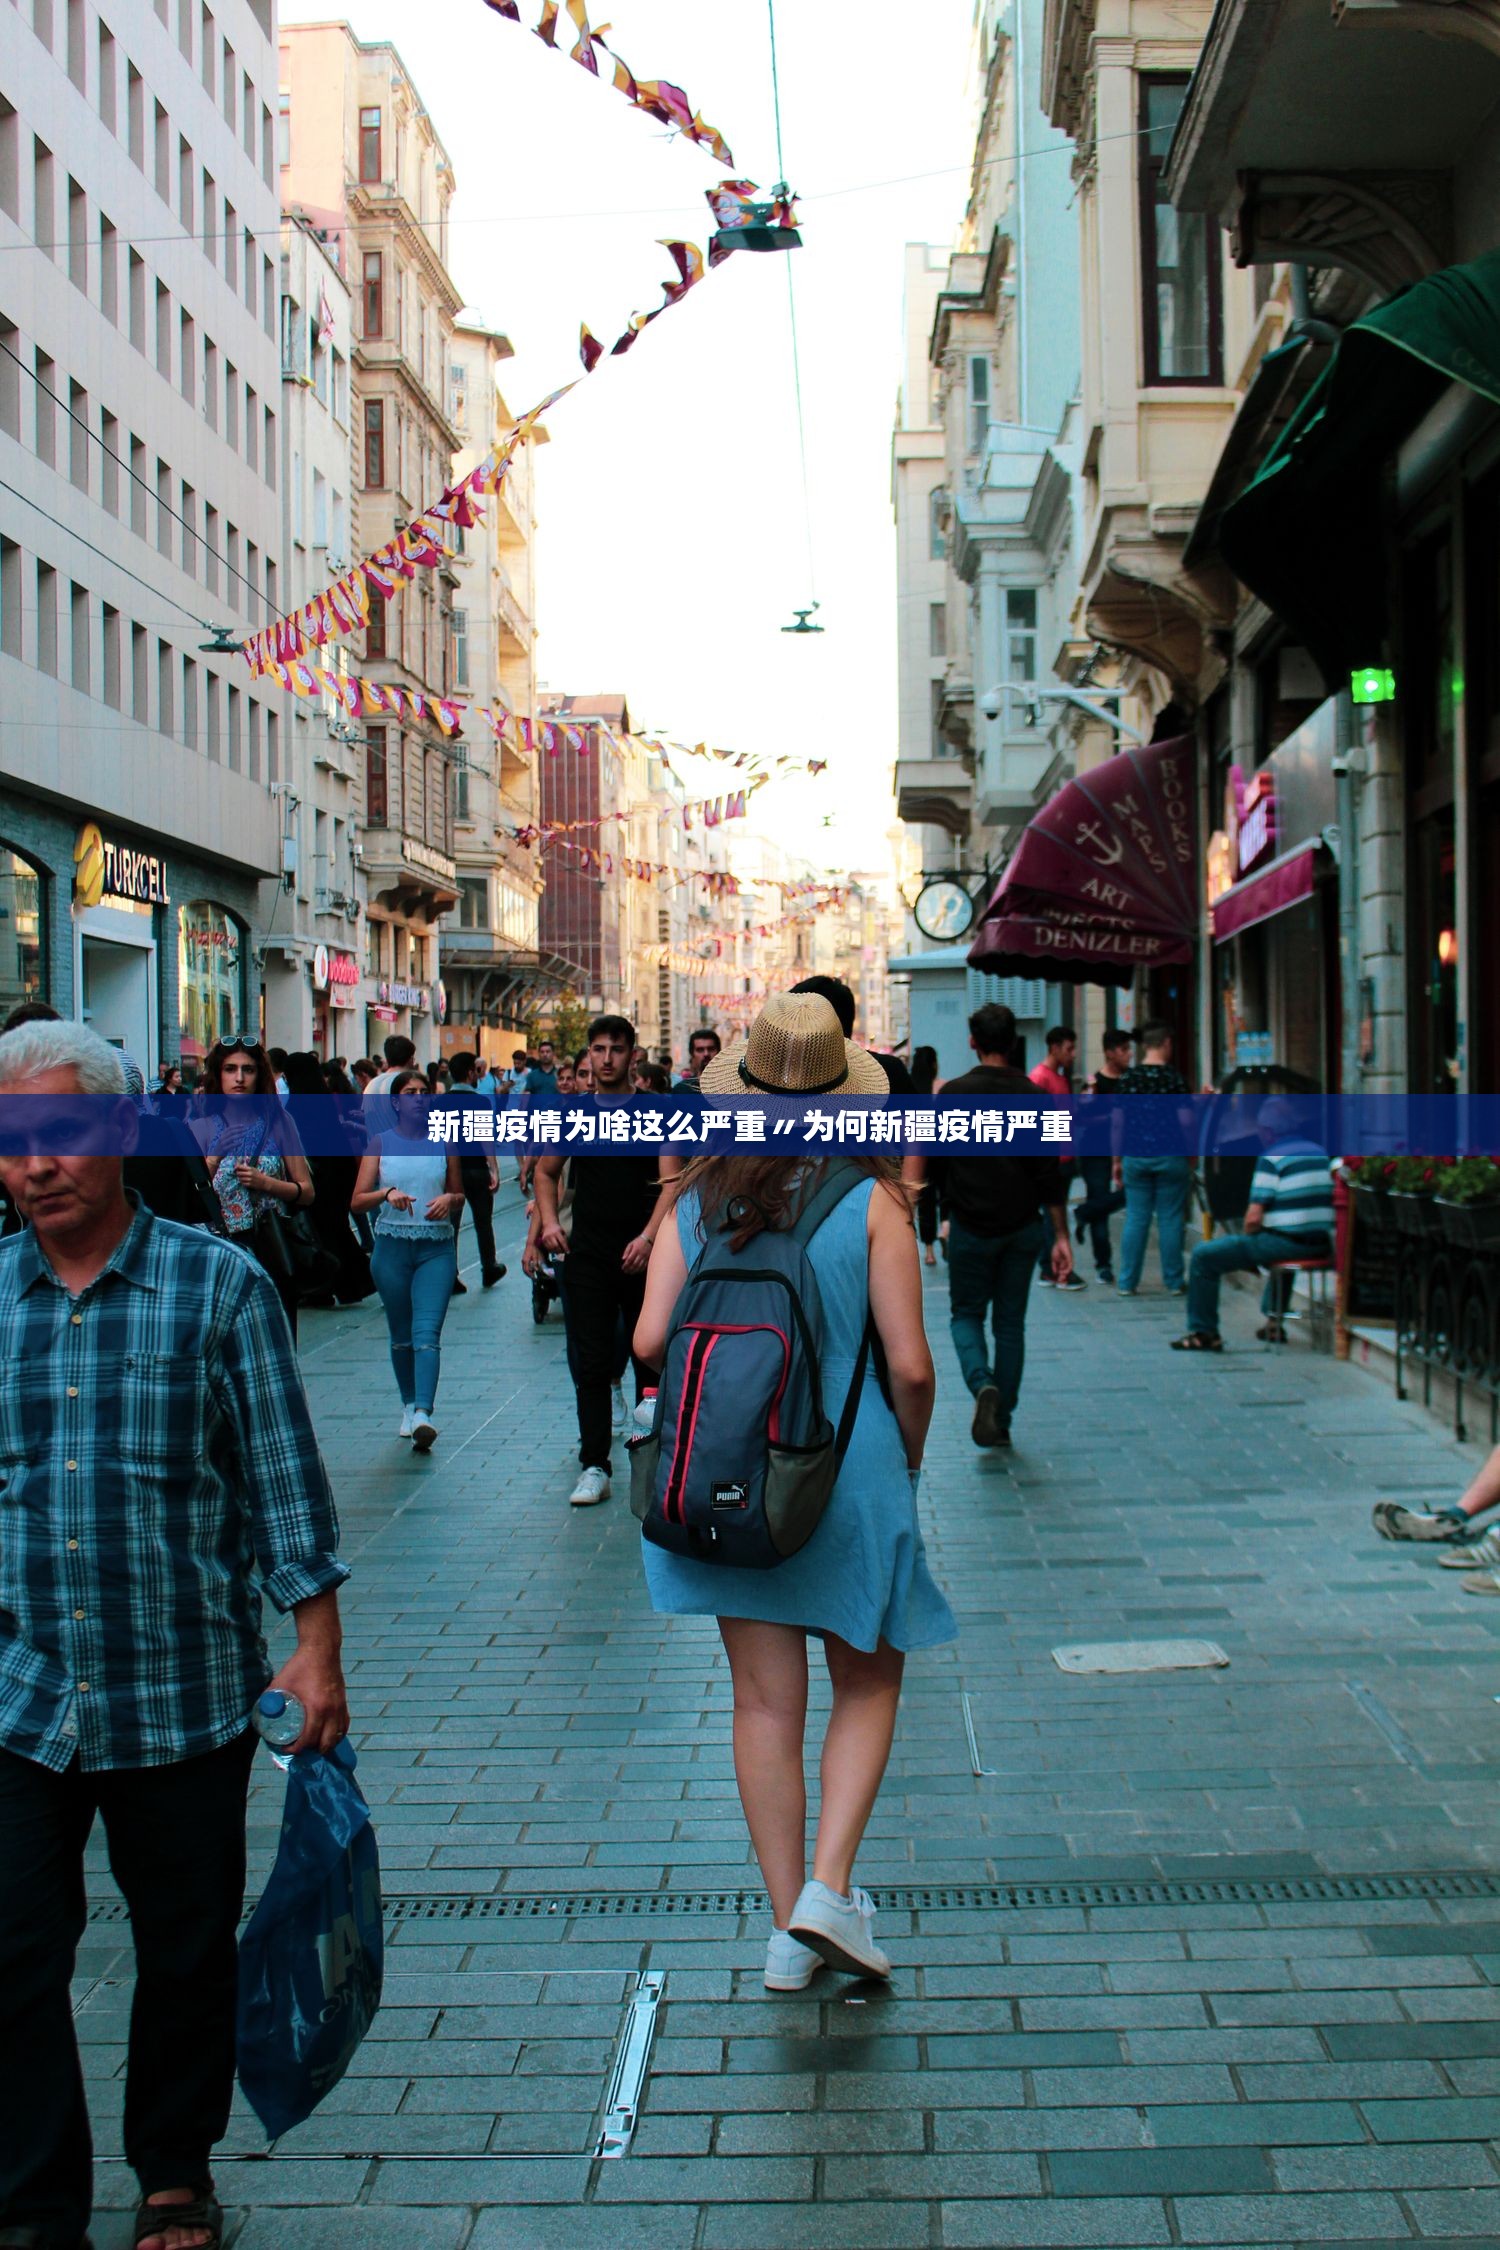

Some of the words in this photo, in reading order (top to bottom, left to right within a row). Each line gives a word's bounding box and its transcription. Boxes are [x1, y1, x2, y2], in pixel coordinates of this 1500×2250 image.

[1113, 794, 1167, 873] MAPS
[1160, 759, 1191, 862] BOOKS
[104, 841, 171, 904] TURKCELL
[1080, 877, 1134, 911] ART
[716, 1491, 740, 1501] PUMA
